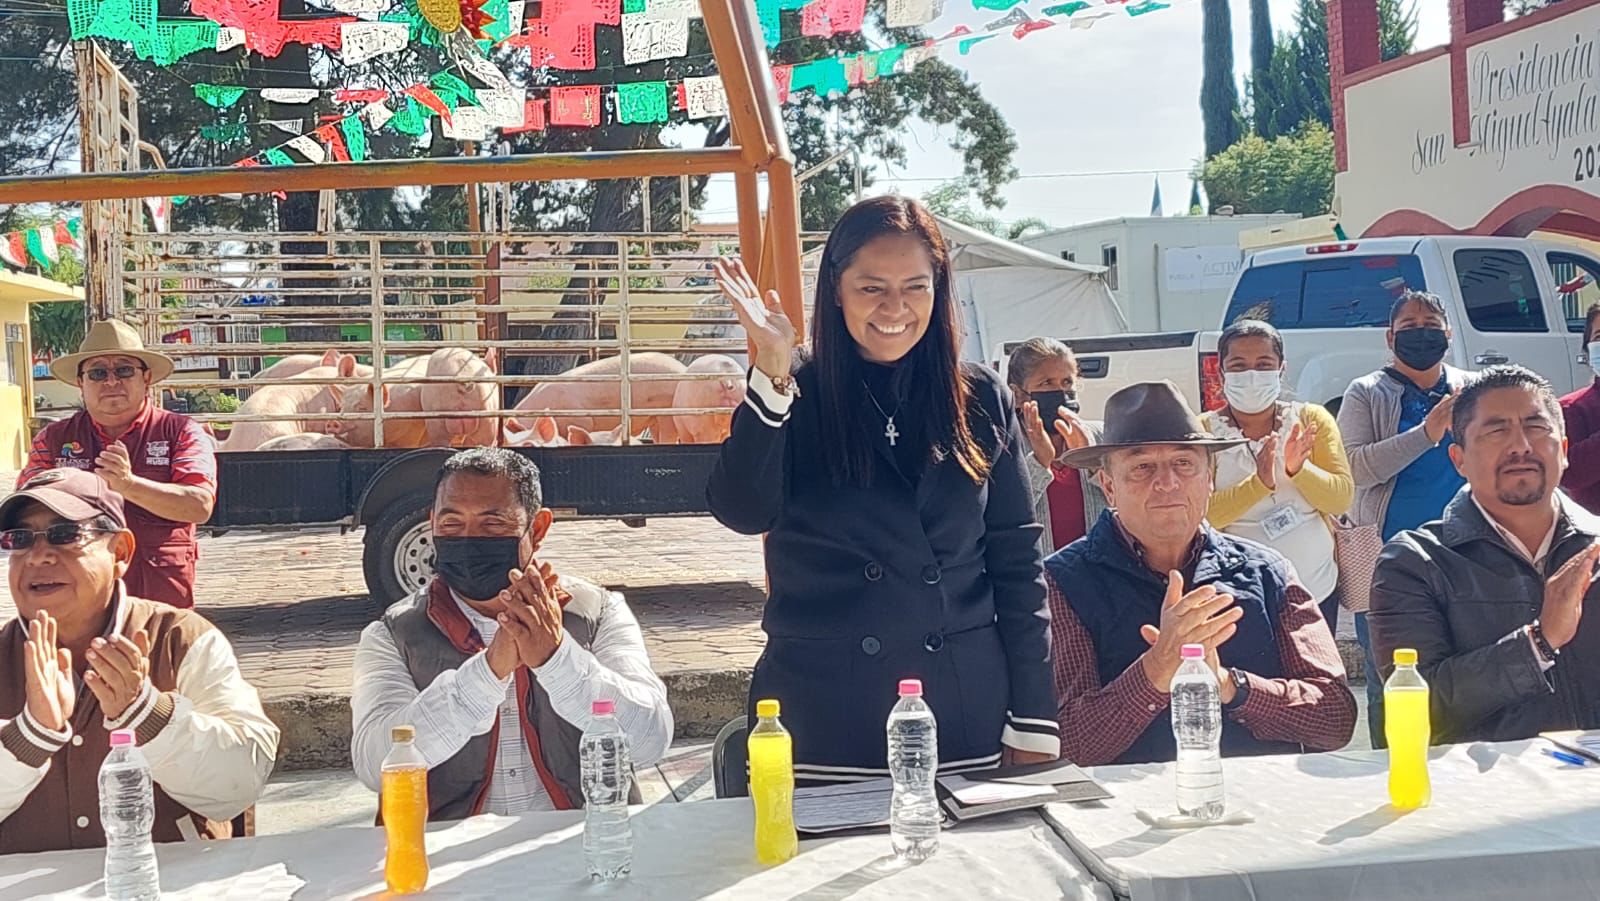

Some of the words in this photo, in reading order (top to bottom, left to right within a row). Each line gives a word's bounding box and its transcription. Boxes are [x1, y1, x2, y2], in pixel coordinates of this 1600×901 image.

[1473, 33, 1594, 110] Presidencia
[1411, 128, 1446, 175] San
[1469, 92, 1541, 172] Miguel
[1574, 143, 1600, 181] 20
[1203, 261, 1242, 273] ACTIV
